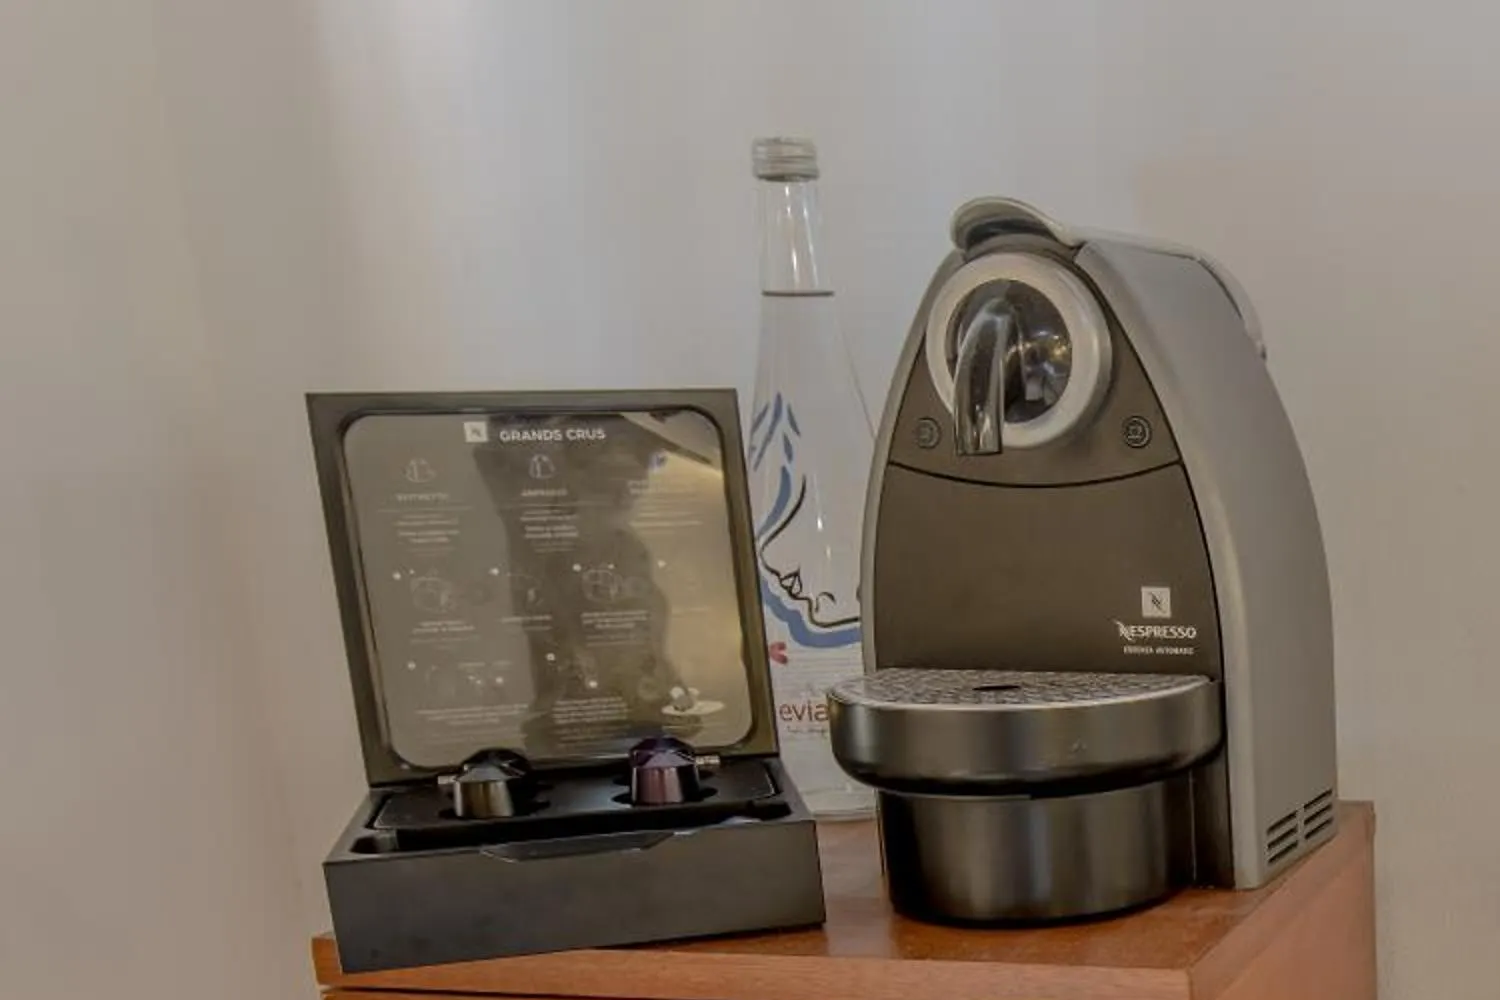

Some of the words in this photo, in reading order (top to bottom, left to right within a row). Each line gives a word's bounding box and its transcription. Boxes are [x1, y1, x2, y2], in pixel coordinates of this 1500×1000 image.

[499, 429, 562, 442] GRANDS
[566, 428, 606, 441] CRUS
[1112, 619, 1197, 642] NESPRESSO
[779, 700, 829, 721] evia
